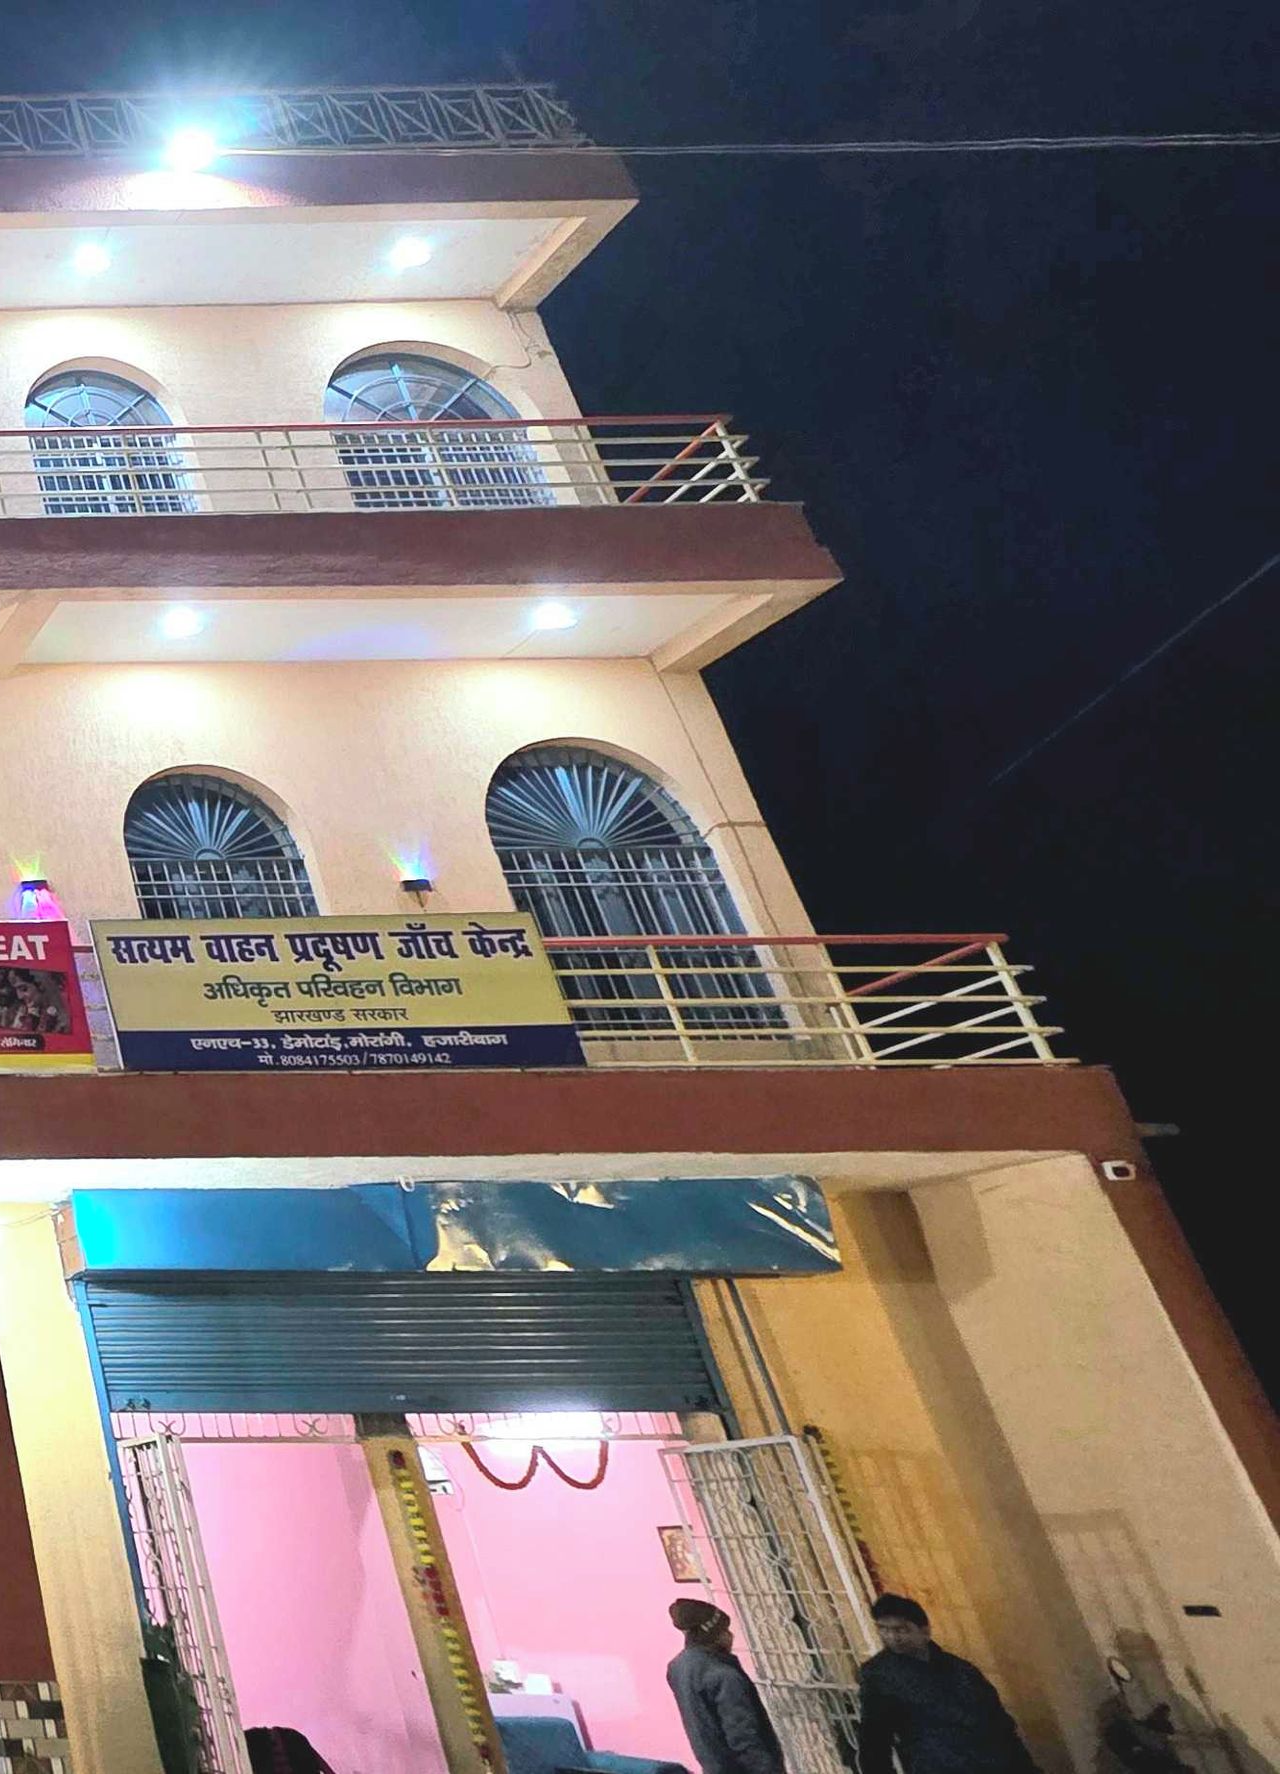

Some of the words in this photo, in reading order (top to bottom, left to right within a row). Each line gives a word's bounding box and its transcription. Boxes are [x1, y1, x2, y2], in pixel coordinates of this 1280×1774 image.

[106, 934, 196, 964] सत्यम
[199, 934, 280, 963] वाहन
[284, 932, 385, 972] प्रदूषण
[461, 921, 533, 959] केन्द्र
[203, 974, 290, 1008] अधिकृत
[296, 972, 386, 999] परिवहन
[388, 971, 464, 996] विभाग
[270, 1008, 346, 1024] झारखण्ड
[349, 1007, 409, 1022] सरकार
